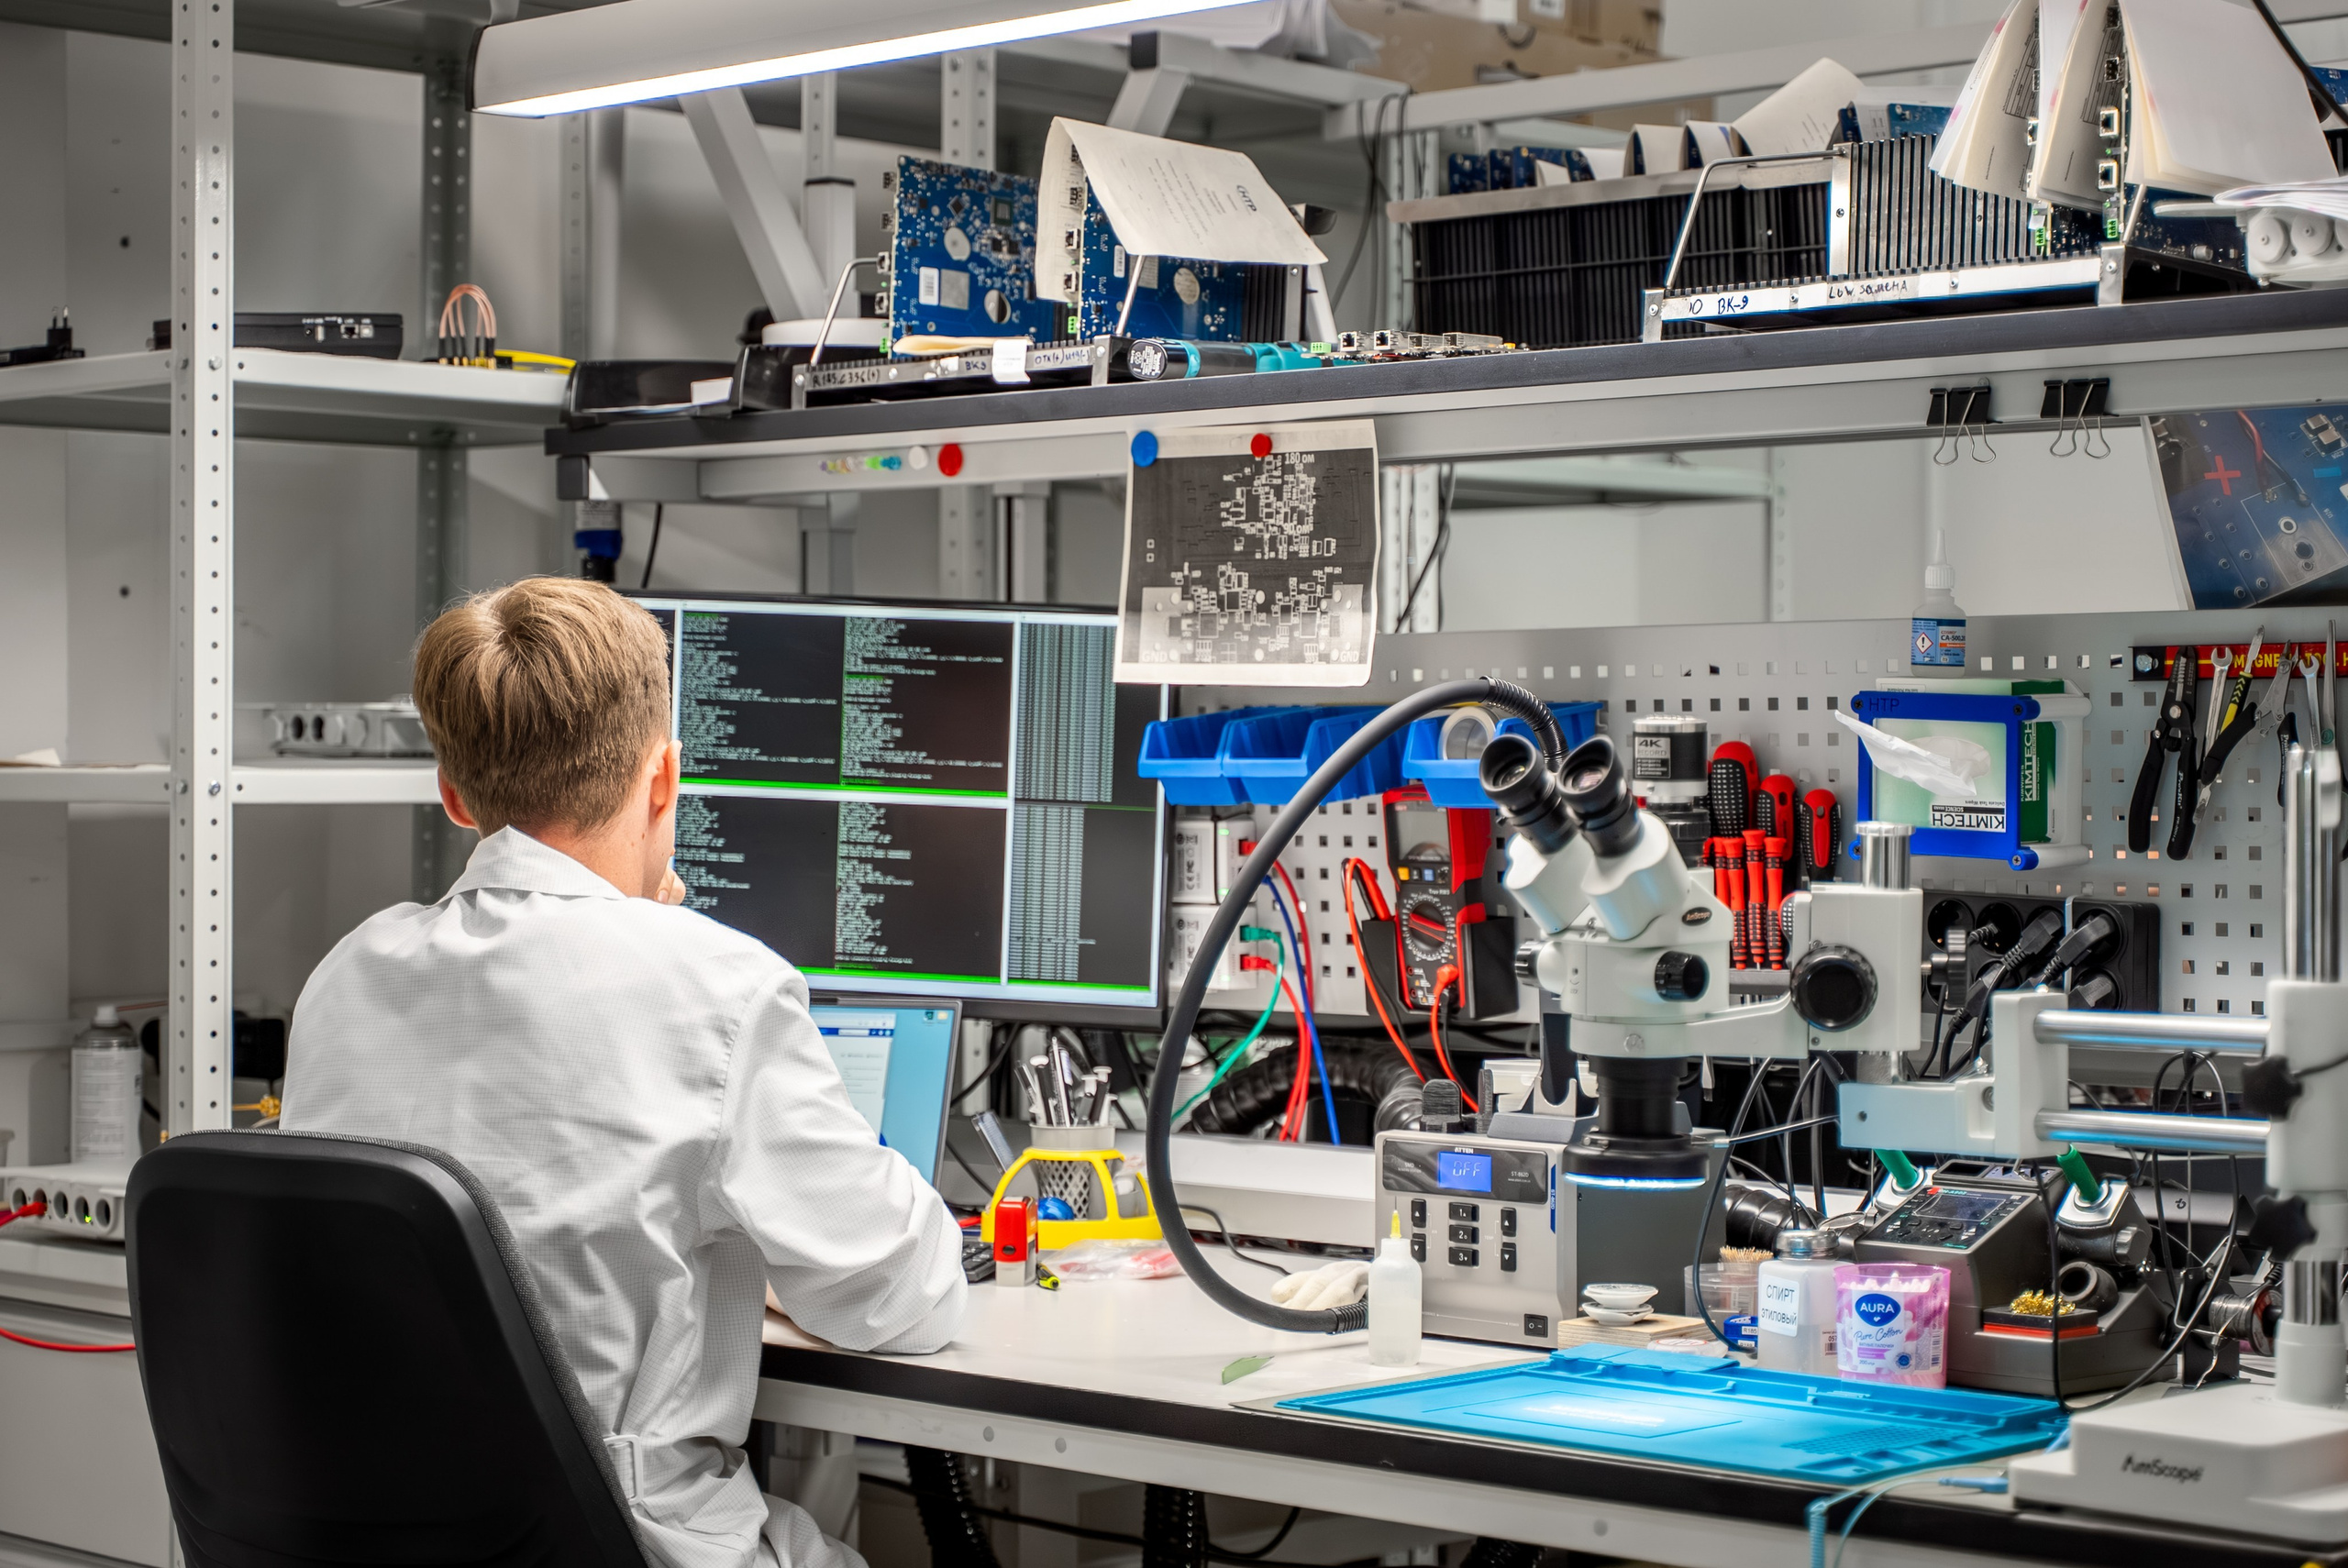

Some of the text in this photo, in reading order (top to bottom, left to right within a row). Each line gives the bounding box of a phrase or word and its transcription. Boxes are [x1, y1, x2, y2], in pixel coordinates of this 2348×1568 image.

[1284, 452, 1301, 465] 180
[1142, 651, 1168, 662] GND
[1340, 650, 1359, 662] GND
[1639, 739, 1663, 748] 4K
[2024, 721, 2032, 802] KIMTECH
[1933, 813, 2005, 830] KIMTECH
[1766, 1284, 1795, 1304] СПИРТ
[1860, 1302, 1895, 1314] AURA
[1854, 1327, 1903, 1342] Pure Cotton
